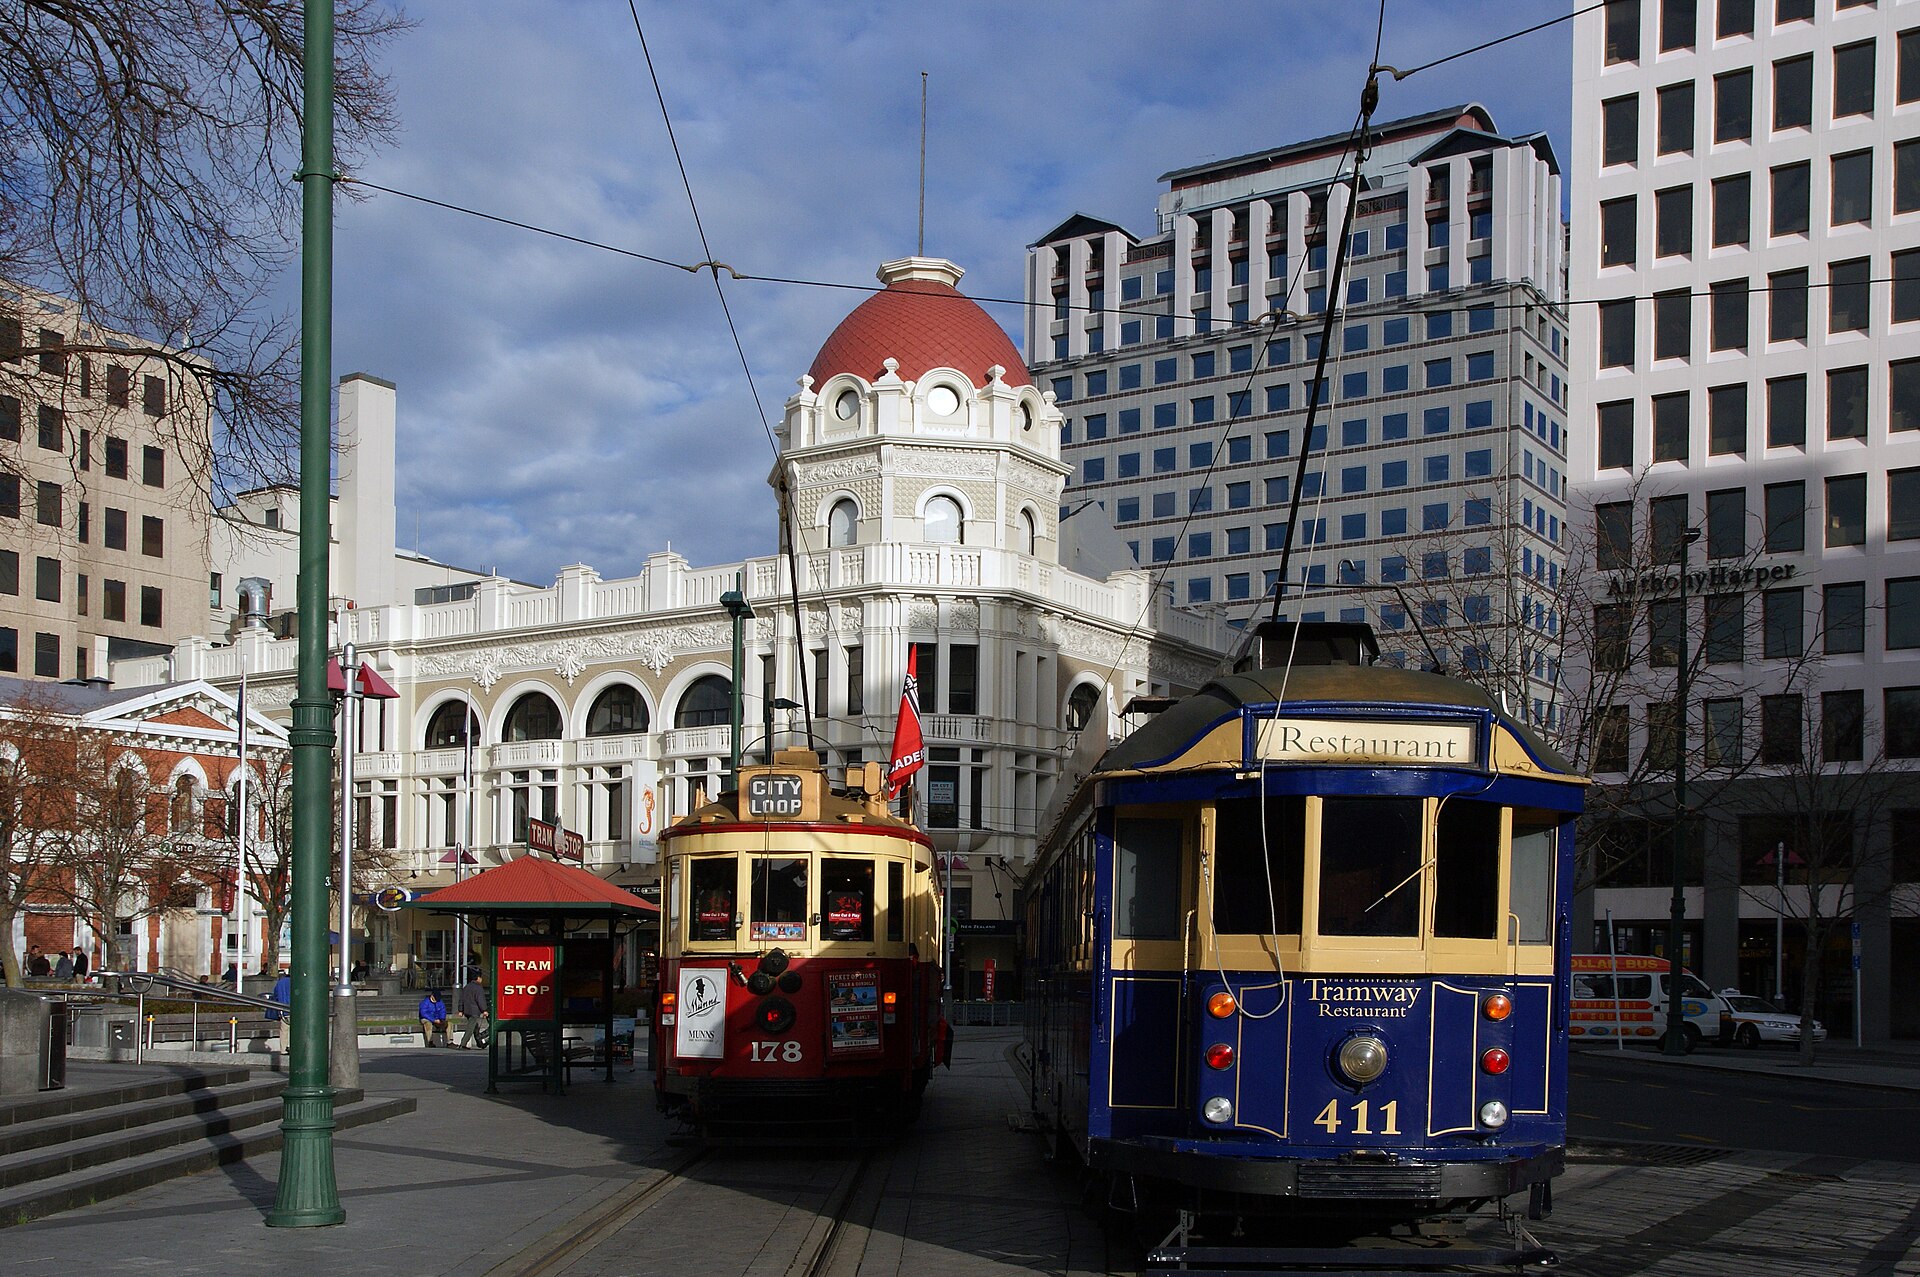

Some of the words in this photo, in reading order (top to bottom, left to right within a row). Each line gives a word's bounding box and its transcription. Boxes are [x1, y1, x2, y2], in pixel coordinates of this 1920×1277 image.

[1280, 726, 1457, 759] Restaurant
[752, 780, 802, 795] CITY
[751, 799, 802, 814] LOOP
[531, 824, 553, 847] TRAM
[564, 835, 582, 856] STOP
[503, 960, 551, 971] TRAM
[1625, 959, 1659, 969] BUS
[504, 984, 550, 995] STOP
[1303, 978, 1422, 1009] Tramway
[1318, 1003, 1407, 1018] Restaurant
[1585, 1001, 1637, 1010] AIRPRT
[1590, 1013, 1638, 1021] SQURE
[688, 1029, 715, 1039] MUNNS
[750, 1040, 803, 1063] 178
[1313, 1098, 1402, 1135] 411
